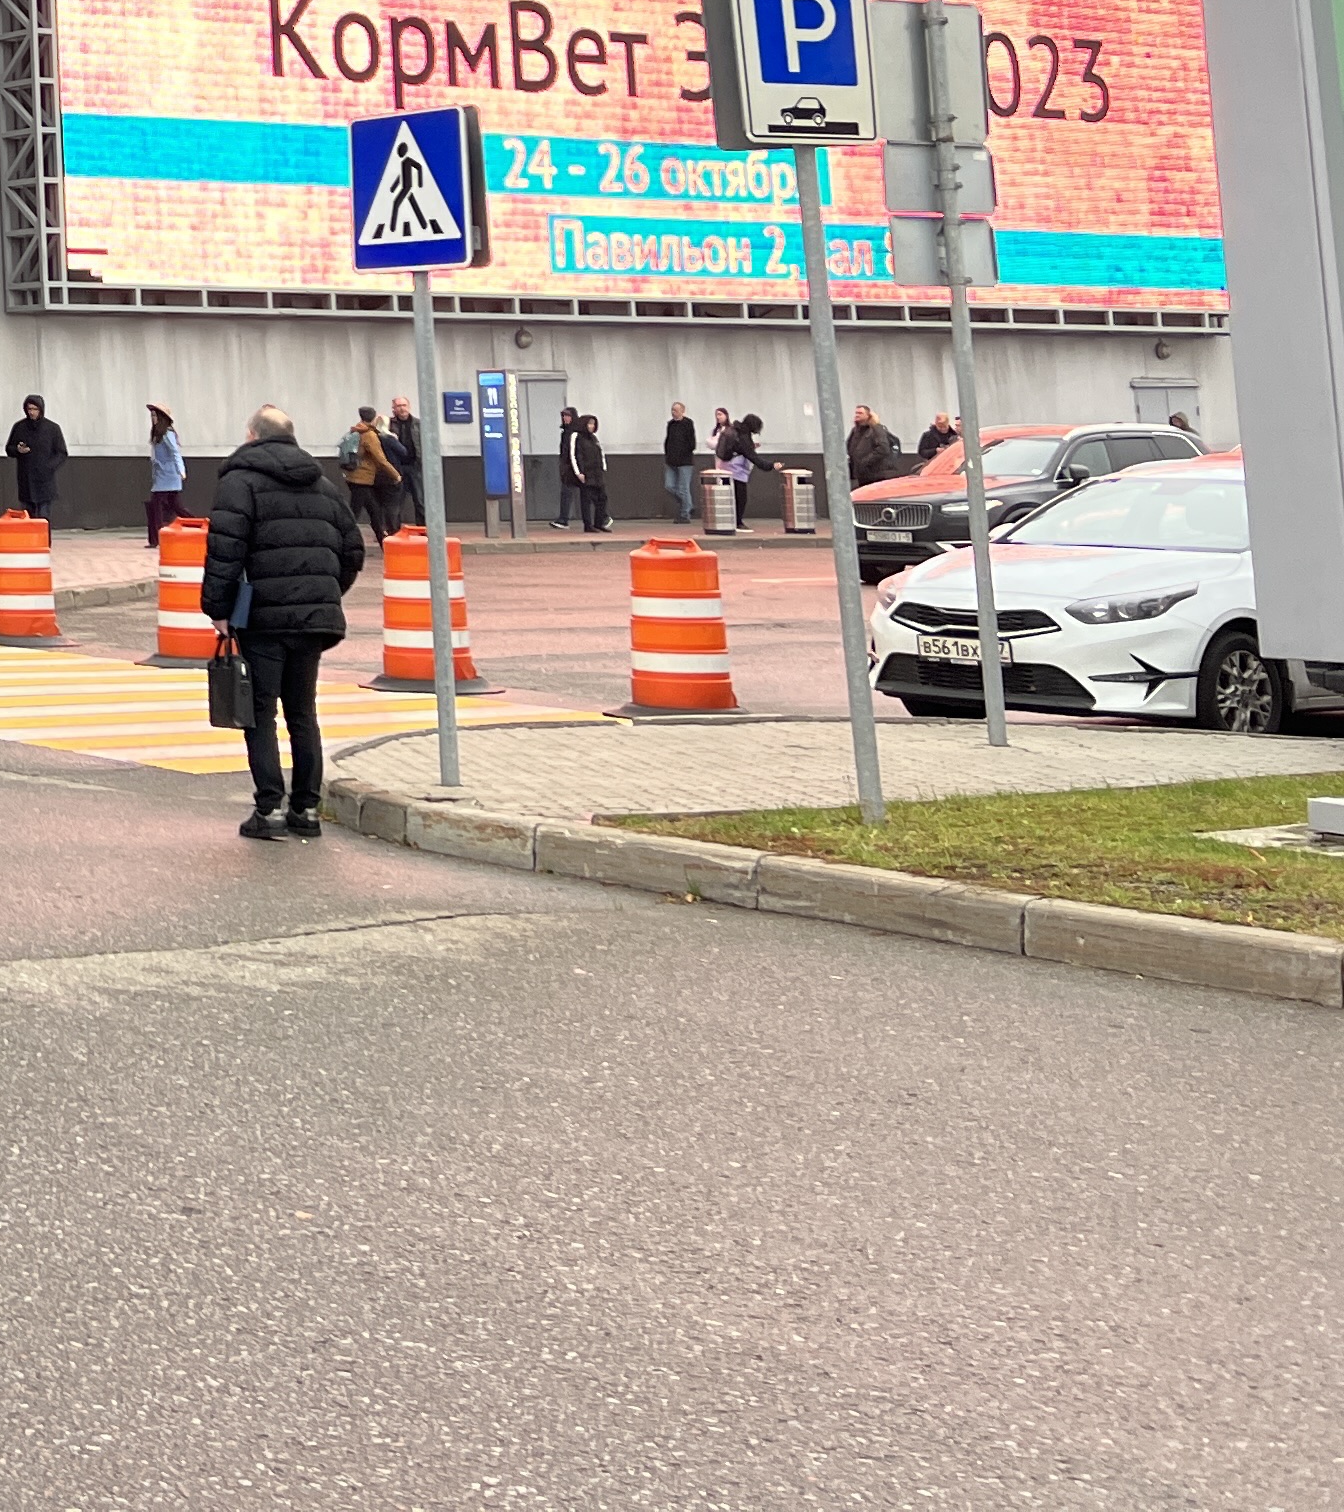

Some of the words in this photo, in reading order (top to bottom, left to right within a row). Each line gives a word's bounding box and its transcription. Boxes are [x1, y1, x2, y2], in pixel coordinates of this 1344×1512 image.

[985, 31, 1111, 123] 023
[503, 138, 558, 190] 24
[598, 143, 651, 194] 26
[660, 149, 799, 208] октябр
[553, 218, 753, 274] Павильон
[762, 225, 800, 281] 2,
[825, 239, 874, 277] ал
